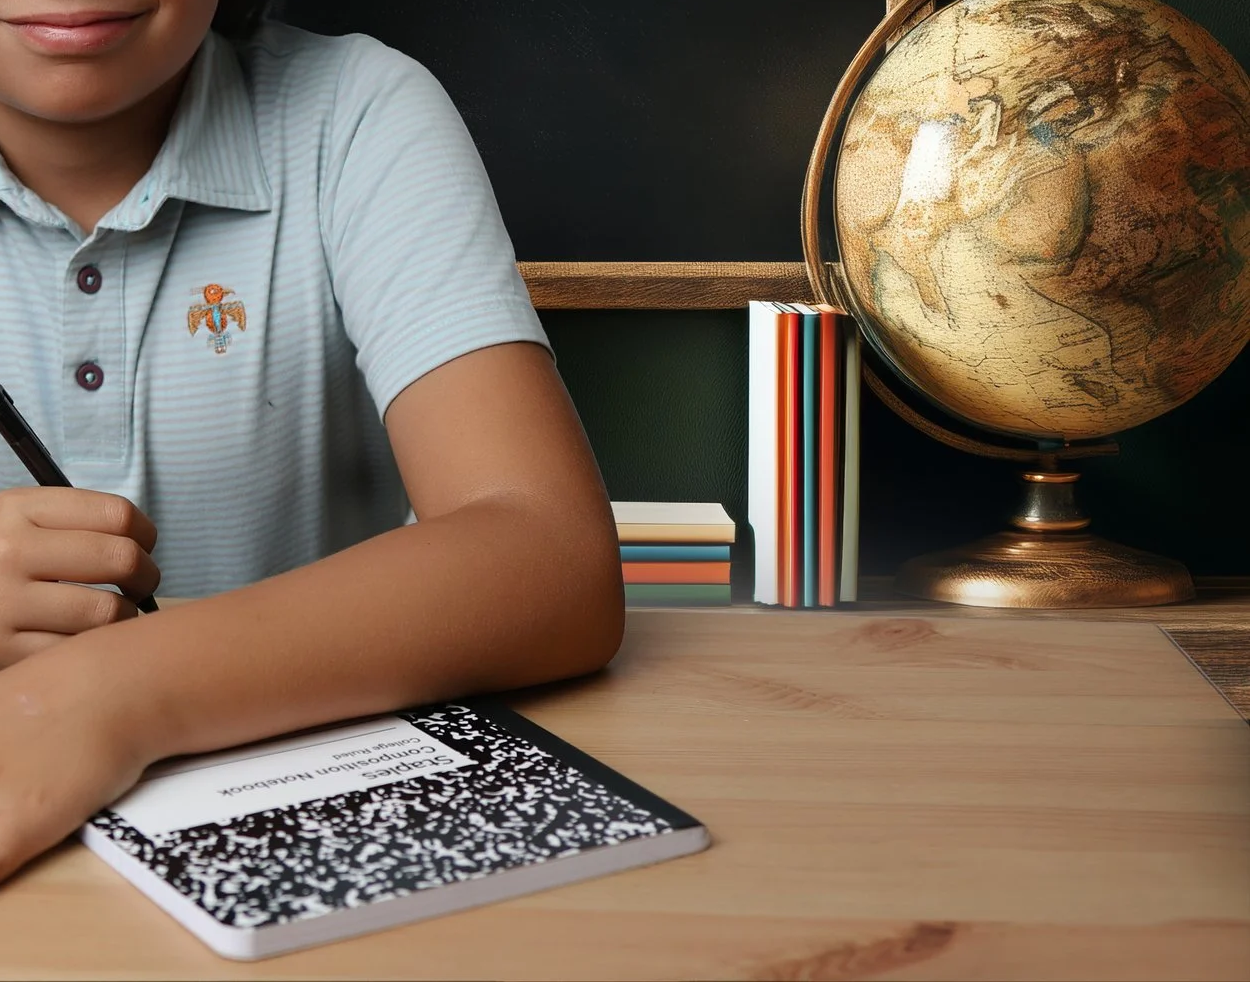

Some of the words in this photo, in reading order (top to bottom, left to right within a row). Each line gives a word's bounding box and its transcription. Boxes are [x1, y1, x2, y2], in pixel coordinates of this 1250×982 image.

[331, 748, 372, 762] Ruled
[372, 737, 422, 752] College
[316, 745, 437, 776] Composition
[361, 754, 455, 781] Staples
[216, 772, 316, 798] Notebook
